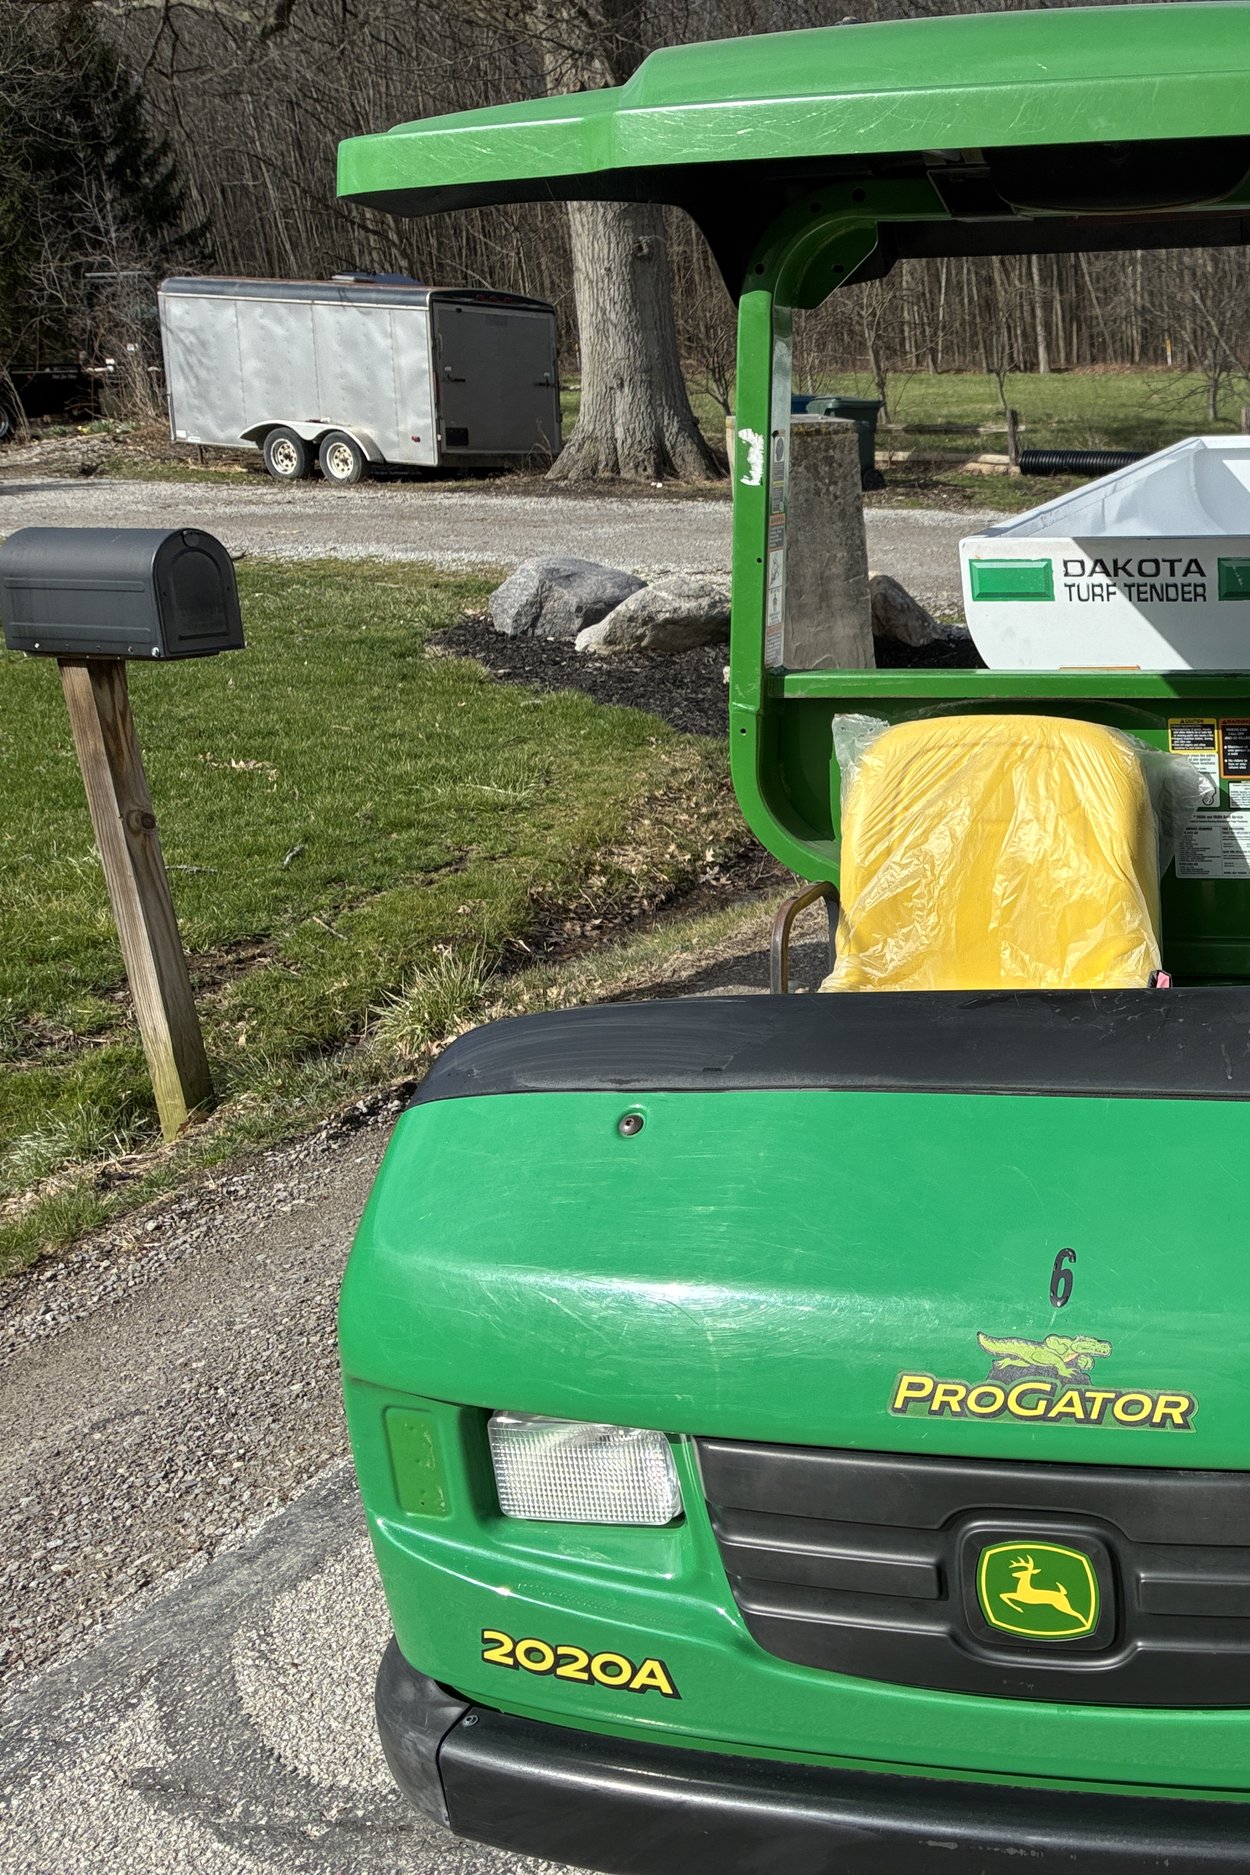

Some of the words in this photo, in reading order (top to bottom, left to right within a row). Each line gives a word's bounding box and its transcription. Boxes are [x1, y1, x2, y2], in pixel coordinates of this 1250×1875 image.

[1063, 558, 1207, 578] DAKOTA
[1064, 582, 1117, 602] TURF
[1124, 582, 1208, 602] TENDER
[1050, 1247, 1077, 1308] 6
[893, 1375, 1192, 1428] PROGATOR
[482, 1629, 680, 1698] 2020A
